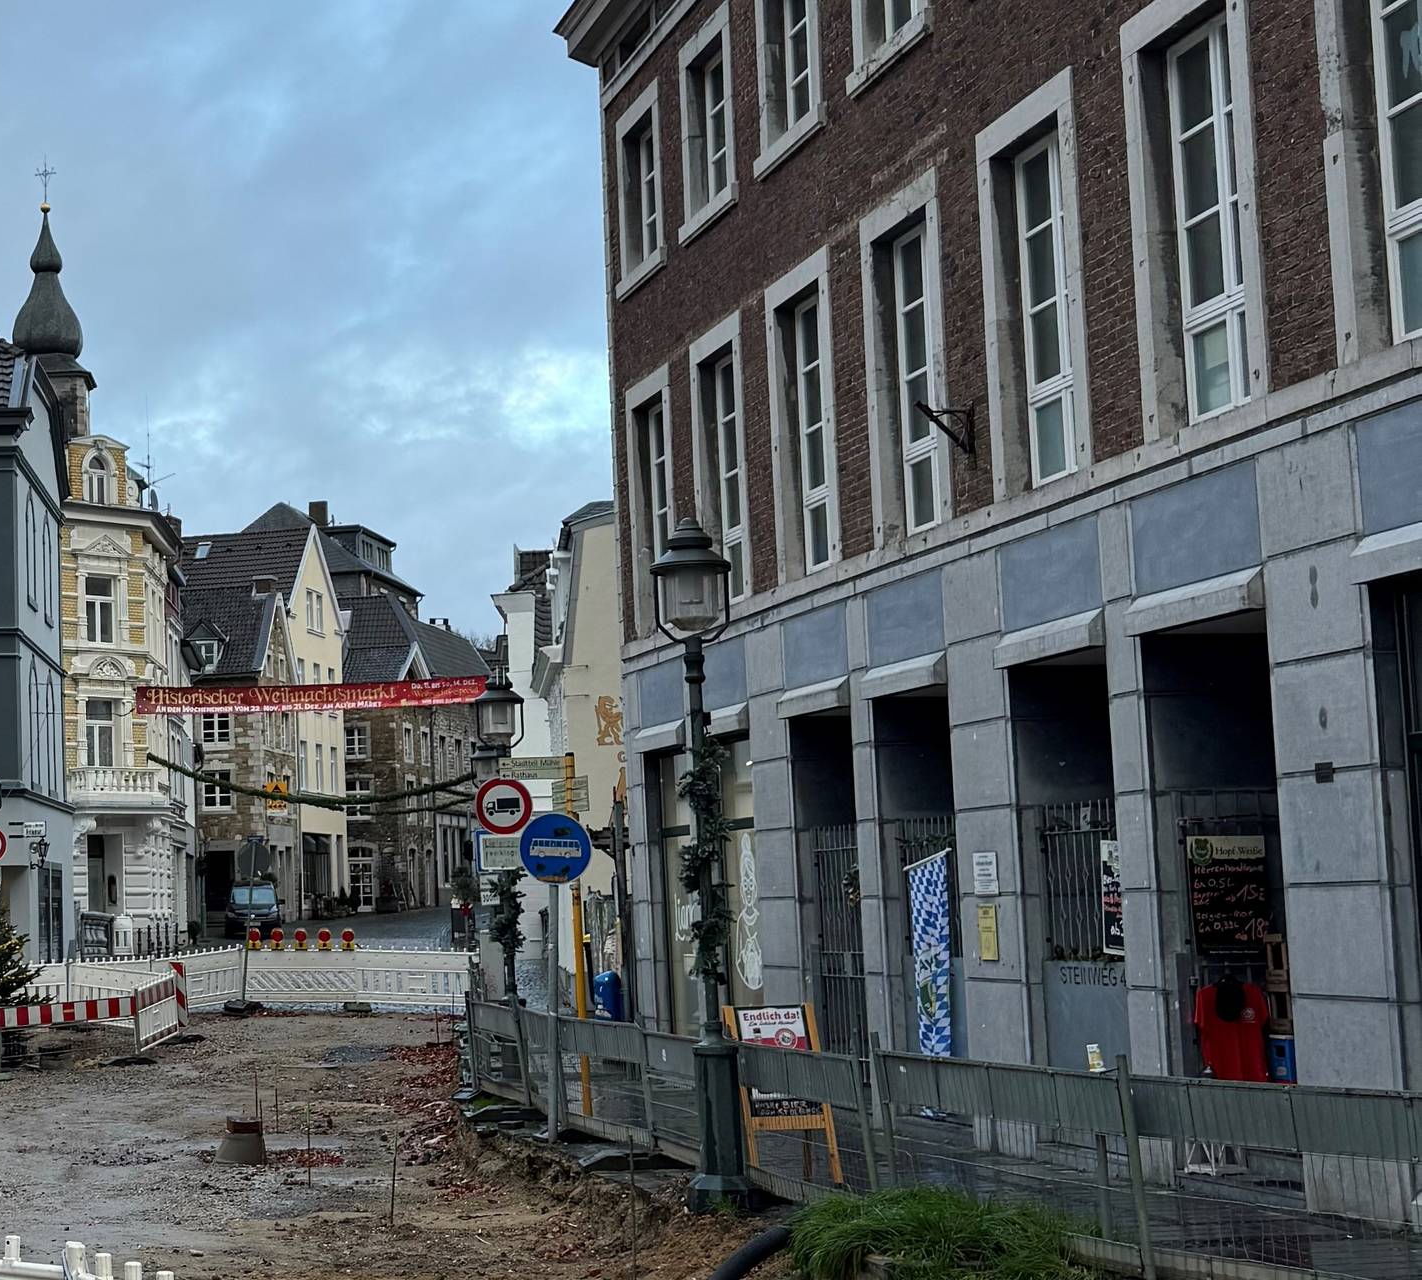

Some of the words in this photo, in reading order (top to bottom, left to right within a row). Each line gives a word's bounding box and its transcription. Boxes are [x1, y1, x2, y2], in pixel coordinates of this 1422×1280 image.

[146, 687, 244, 706] Historischer
[249, 683, 397, 704] Weihnachtsmarkt
[1059, 966, 1118, 987] STEINWEG
[743, 1011, 781, 1022] Endlich
[784, 1010, 800, 1020] da!
